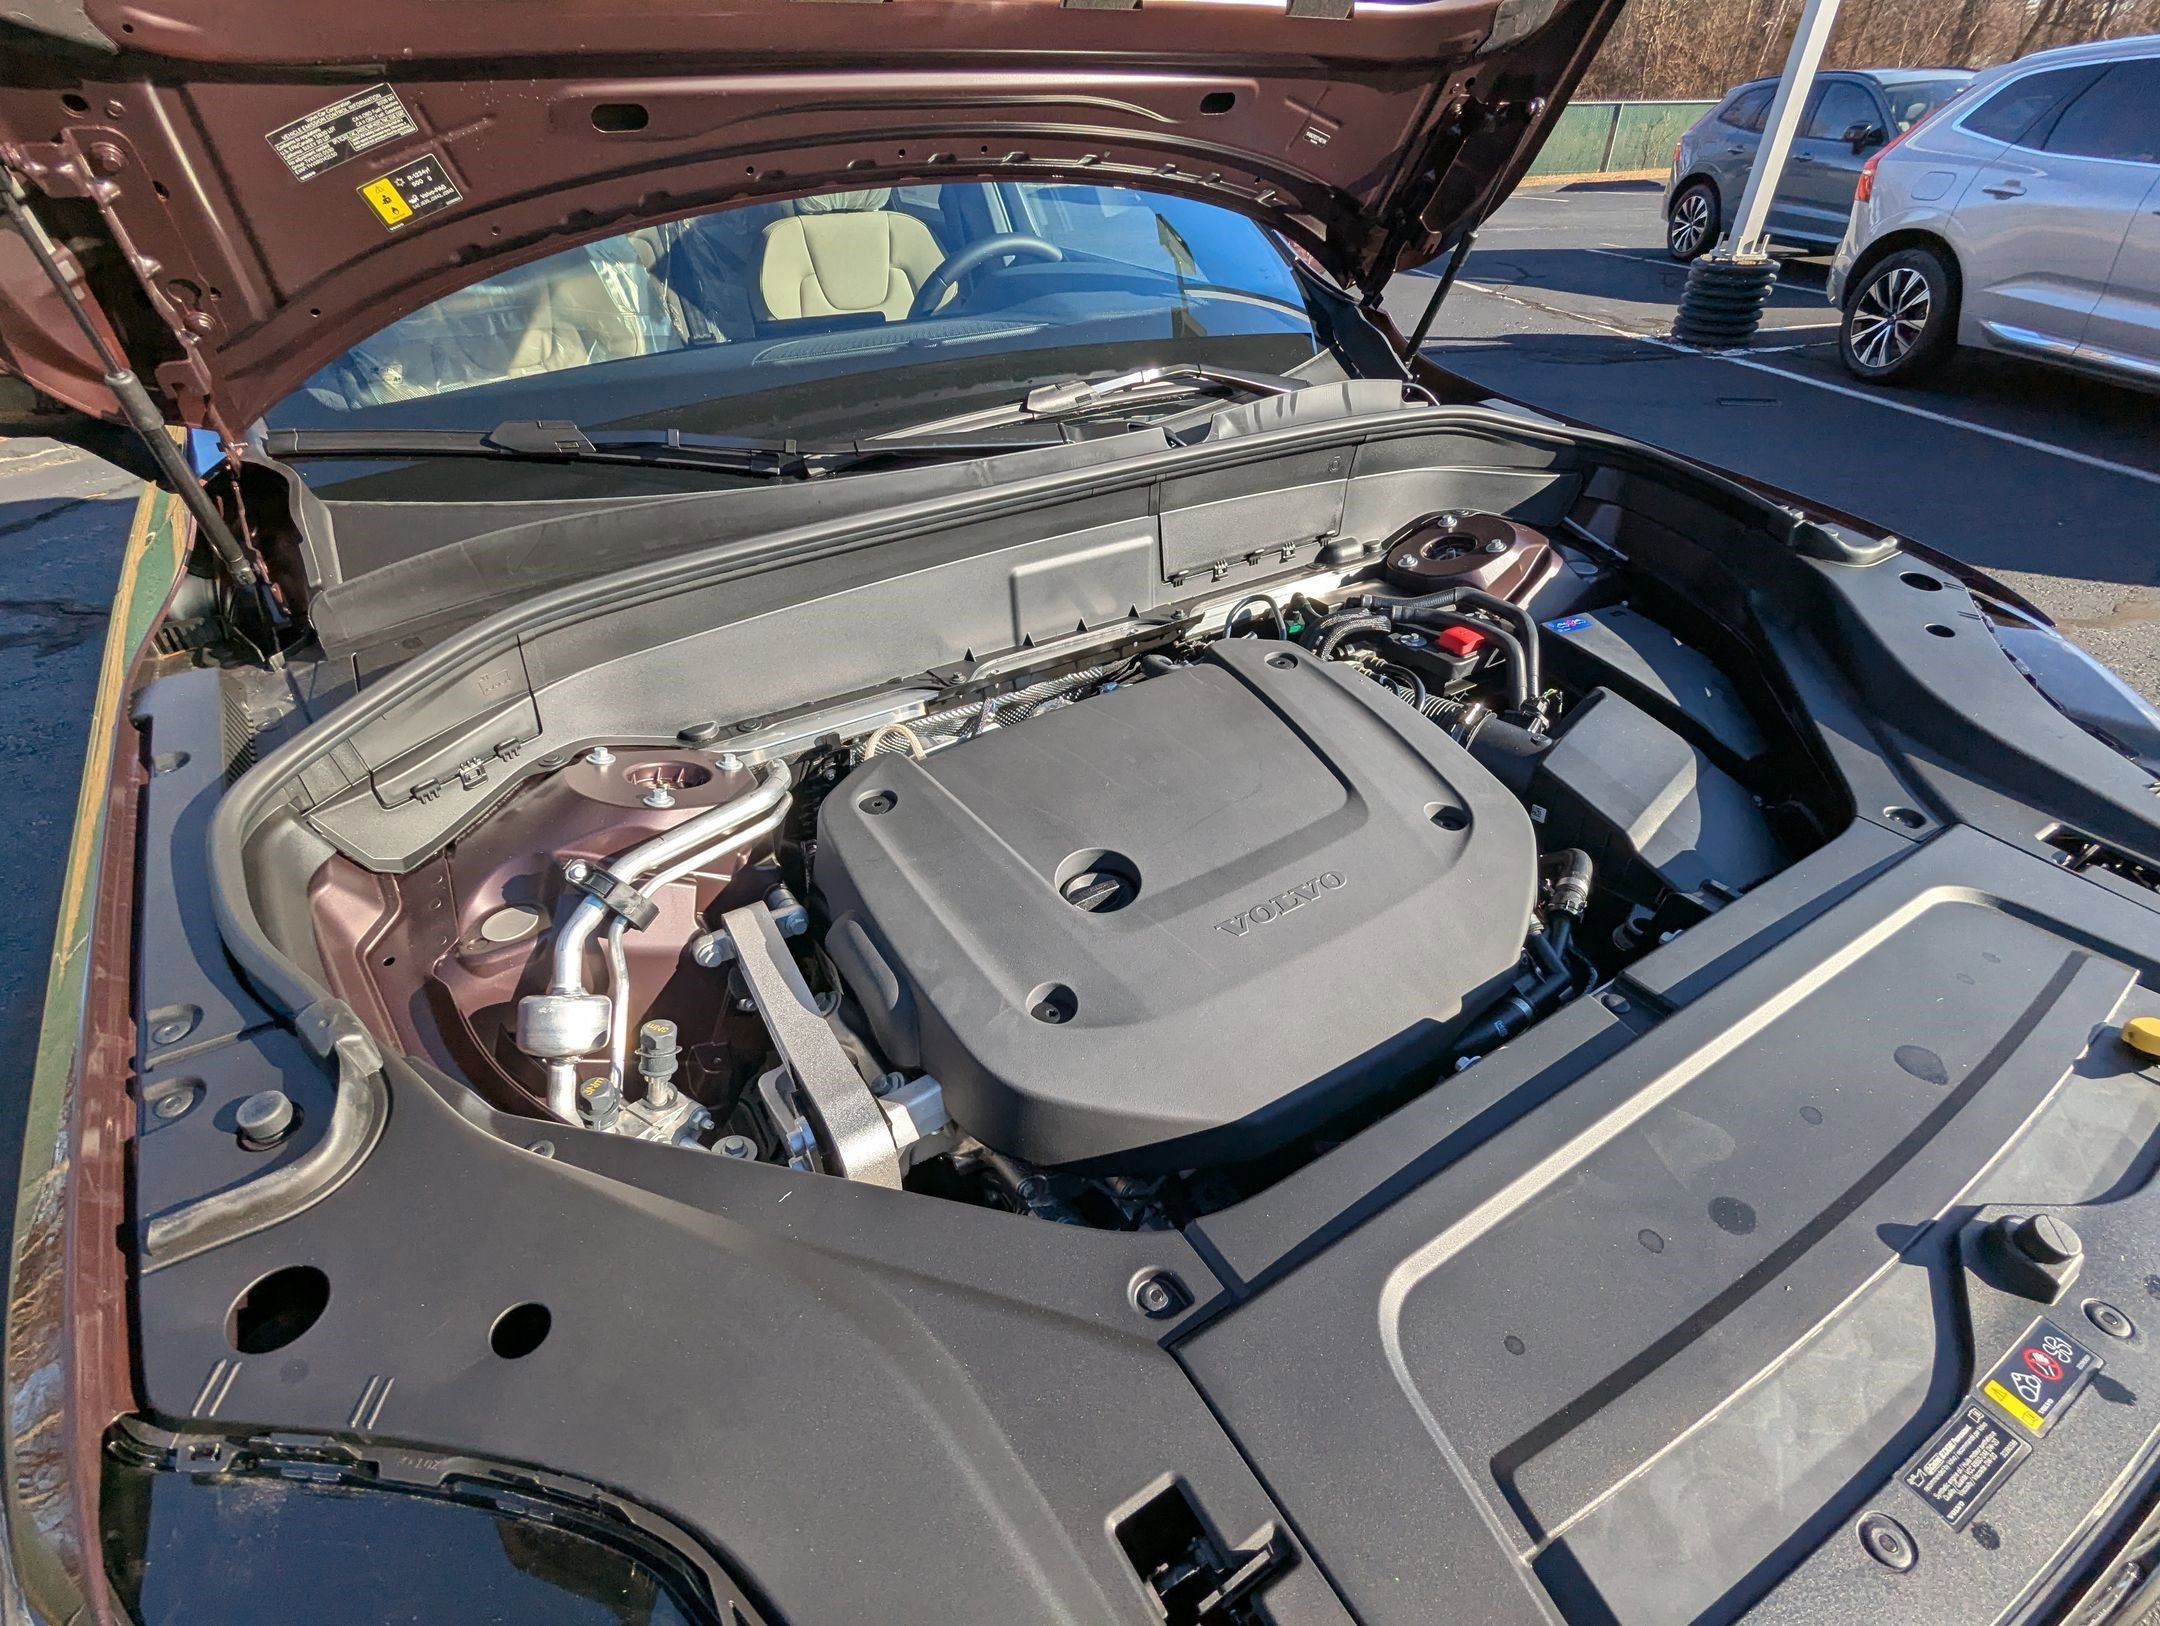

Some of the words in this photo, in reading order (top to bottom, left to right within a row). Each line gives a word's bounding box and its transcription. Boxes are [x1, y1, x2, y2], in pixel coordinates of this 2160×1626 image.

[281, 128, 302, 140] VEHICLE
[301, 117, 326, 130] EMISSION
[325, 107, 349, 119] CONTROL
[348, 93, 381, 110] INFORMATION
[1213, 870, 1347, 938] VOLVO
[1947, 1500, 1965, 1519] VOLVO
